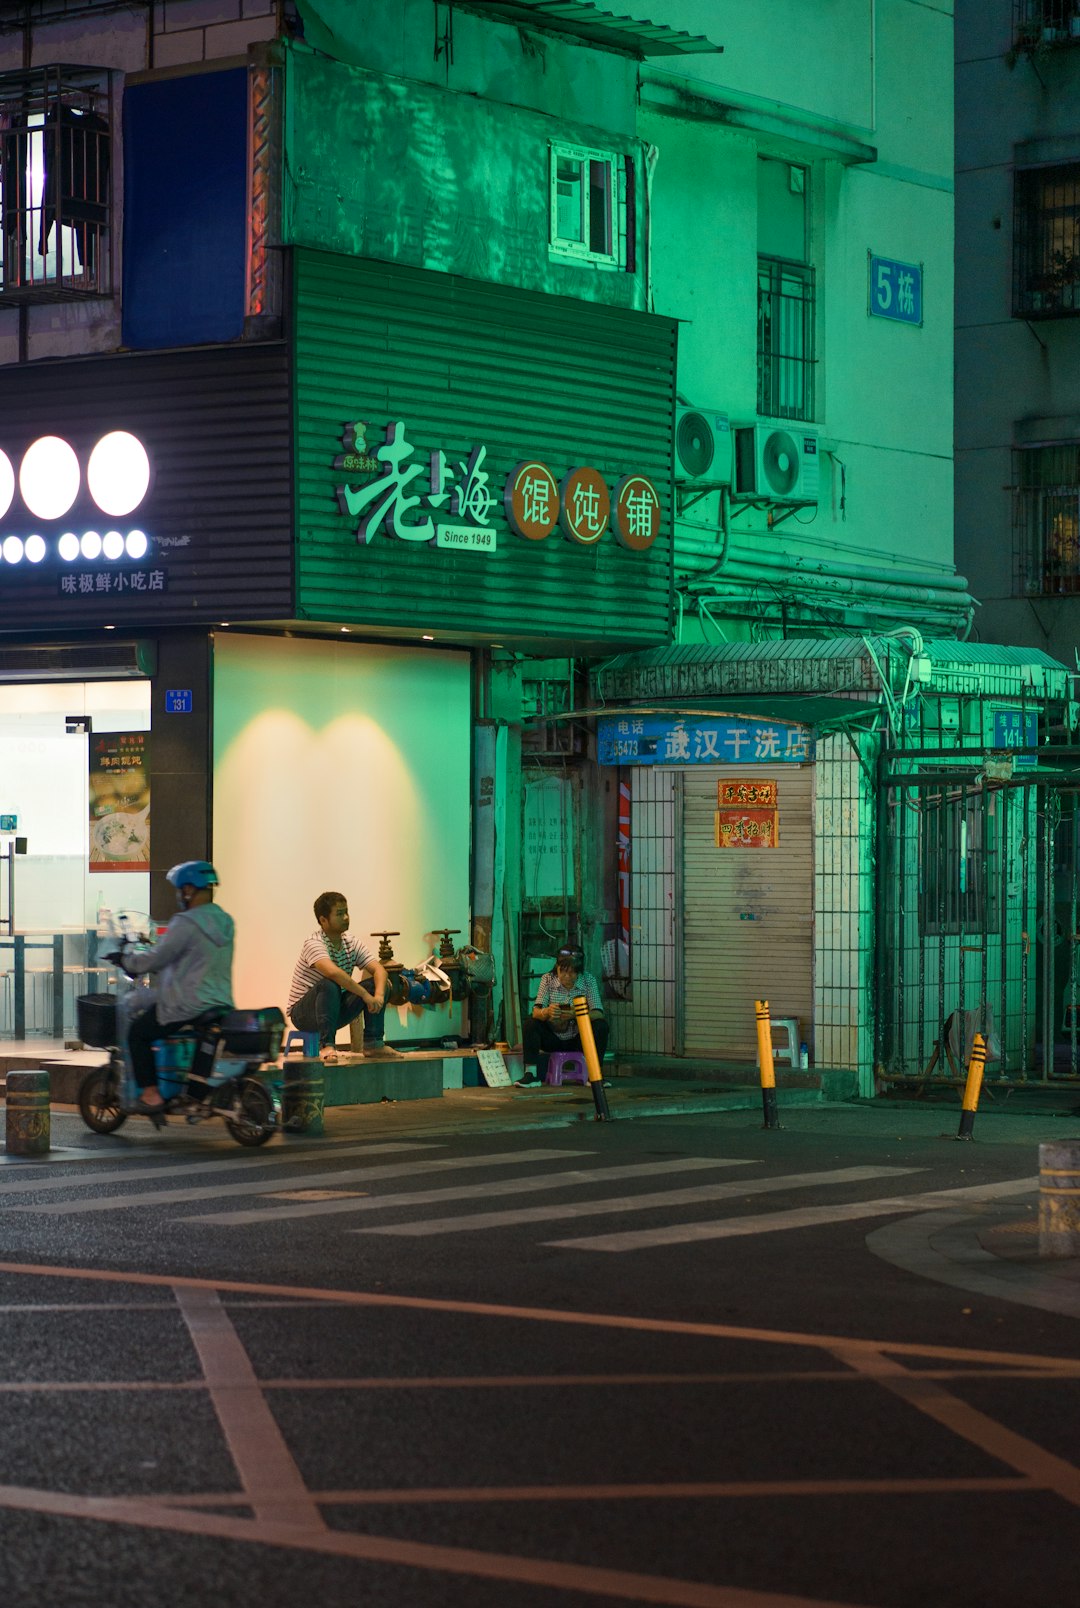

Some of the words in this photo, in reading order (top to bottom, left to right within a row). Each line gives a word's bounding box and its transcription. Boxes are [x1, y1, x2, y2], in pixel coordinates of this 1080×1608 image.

[877, 265, 915, 315] 5栋
[341, 420, 498, 545] 老上海
[521, 474, 654, 538] 馄饨铺
[444, 530, 469, 544] Since
[471, 533, 492, 546] 1949
[60, 569, 165, 595] 味极鲜小吃店
[172, 698, 186, 711] 131
[617, 719, 644, 735] 电话
